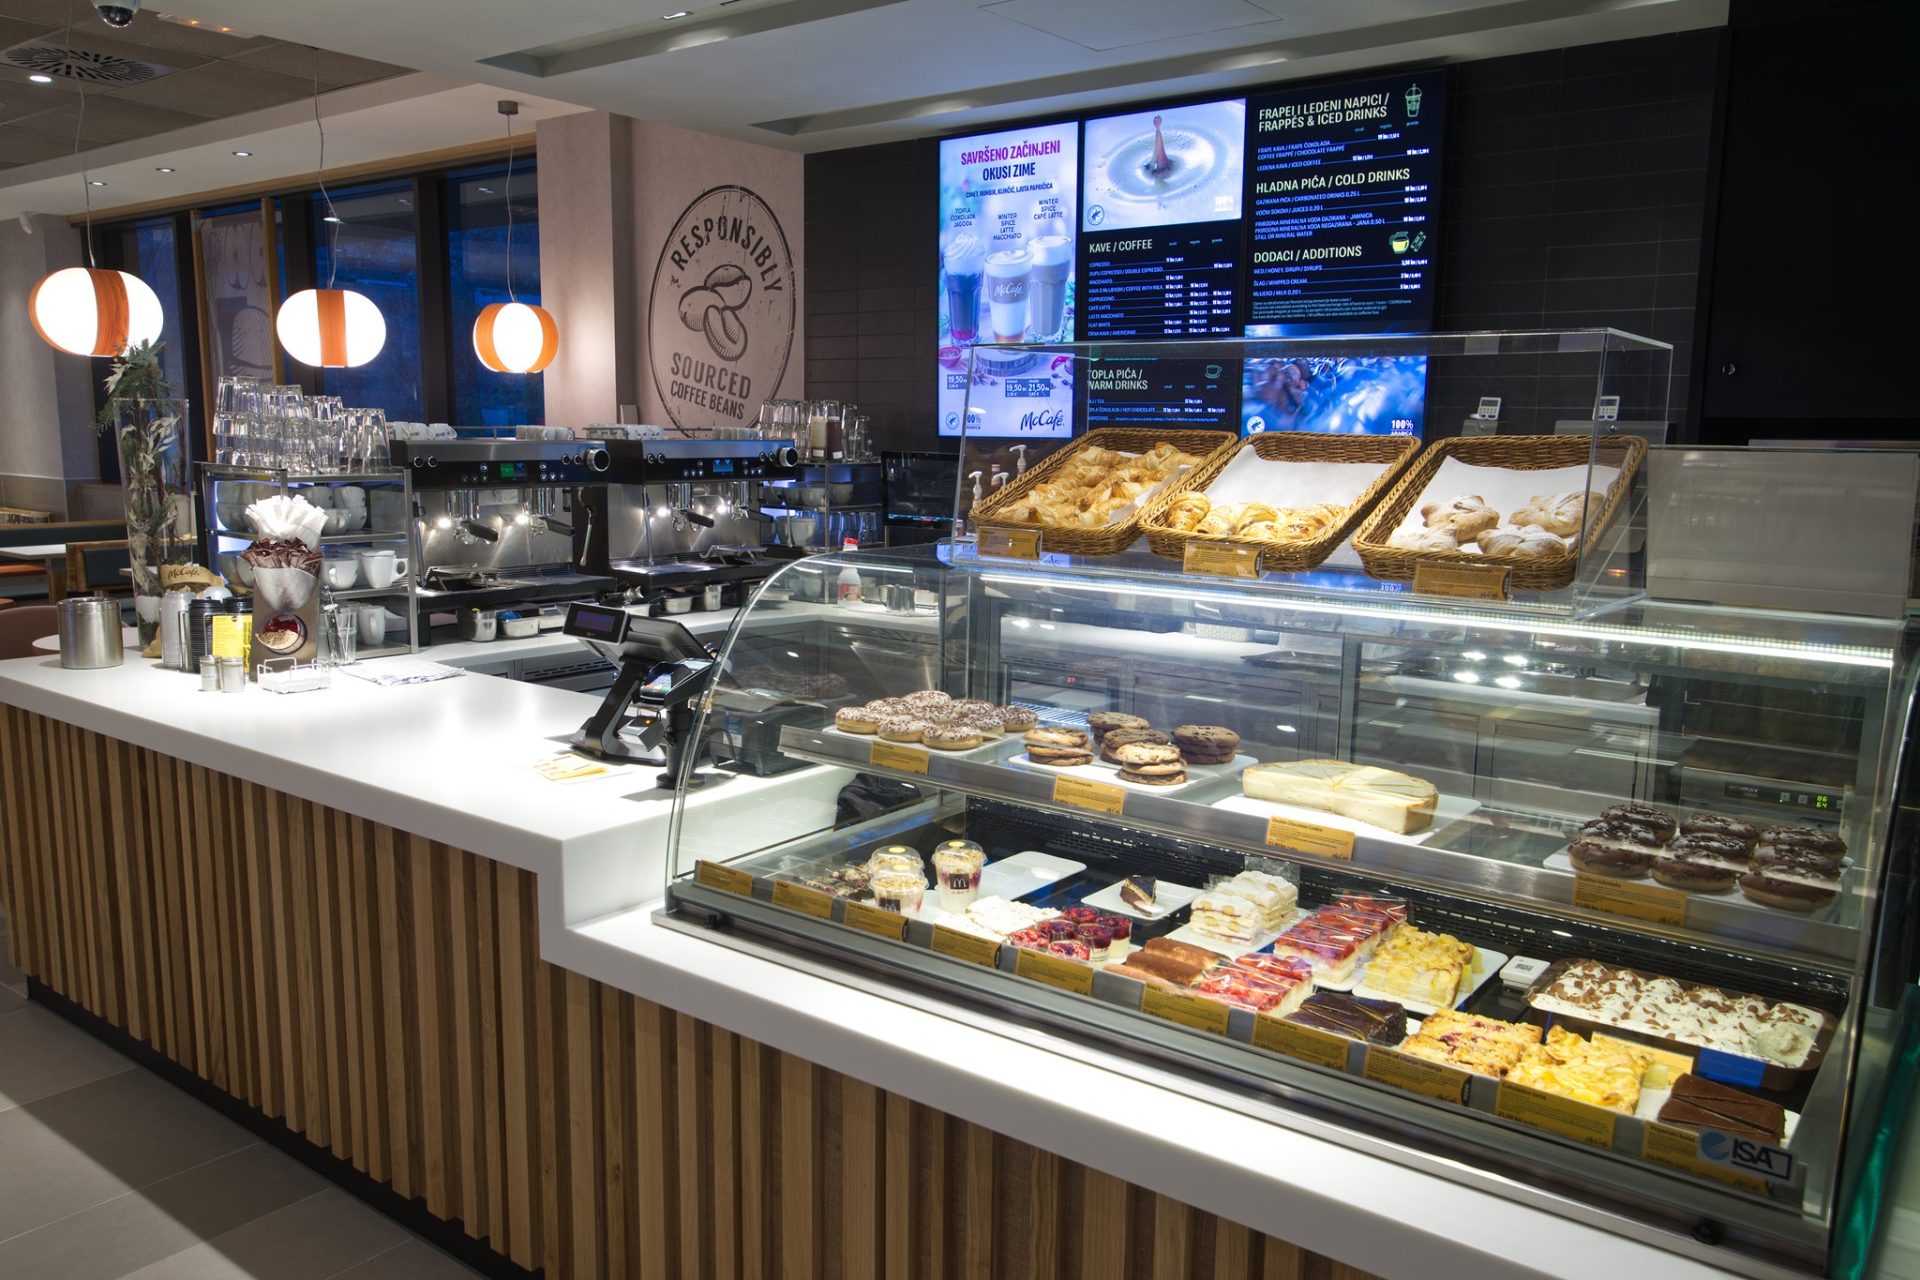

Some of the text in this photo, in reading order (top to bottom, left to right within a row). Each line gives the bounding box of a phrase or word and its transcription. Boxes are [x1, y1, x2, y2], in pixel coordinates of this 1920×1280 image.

[1304, 100, 1341, 115] LEDENI
[1345, 94, 1382, 109] NAPICI
[1259, 106, 1387, 132] FRAPPÉS & ICED DRINKS
[961, 140, 1060, 165] SAVRŠENO ZAČINJENI
[983, 162, 1036, 180] OKUSI ZIME
[1256, 168, 1410, 193] HLADNA PIĆA / COLD DRINKS
[671, 216, 783, 292] RESPONSIBLY
[1089, 239, 1152, 253] KAVE / COFFEE
[1254, 246, 1362, 263] DODACI / ADDITIONS
[671, 352, 752, 400] SOURCED
[1117, 367, 1136, 379] PIĆA
[1139, 369, 1143, 379] /
[1115, 380, 1148, 390] DRINKS
[670, 380, 744, 420] COFFEE BEANS
[1020, 410, 1063, 430] McCafé
[1392, 420, 1414, 428] 100%
[168, 566, 200, 580] McCafé
[1732, 1138, 1773, 1169] ISA
